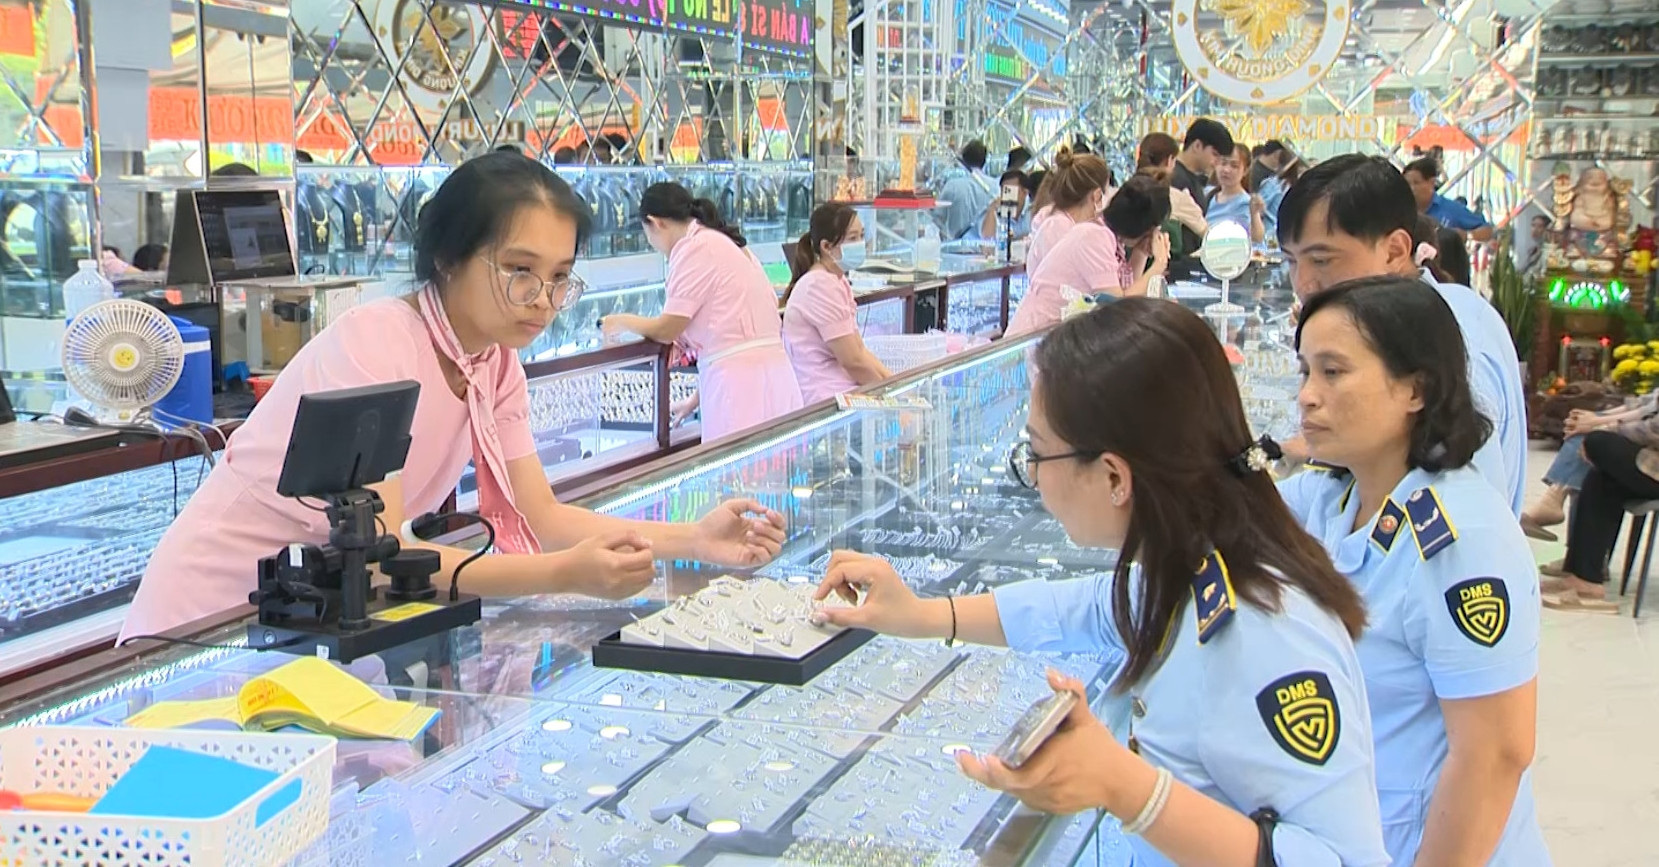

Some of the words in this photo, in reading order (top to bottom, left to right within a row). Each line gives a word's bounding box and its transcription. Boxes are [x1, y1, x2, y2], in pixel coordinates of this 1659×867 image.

[1251, 117, 1378, 139] DIAMOND
[1459, 582, 1493, 601] DMS
[1276, 679, 1318, 706] DMS
